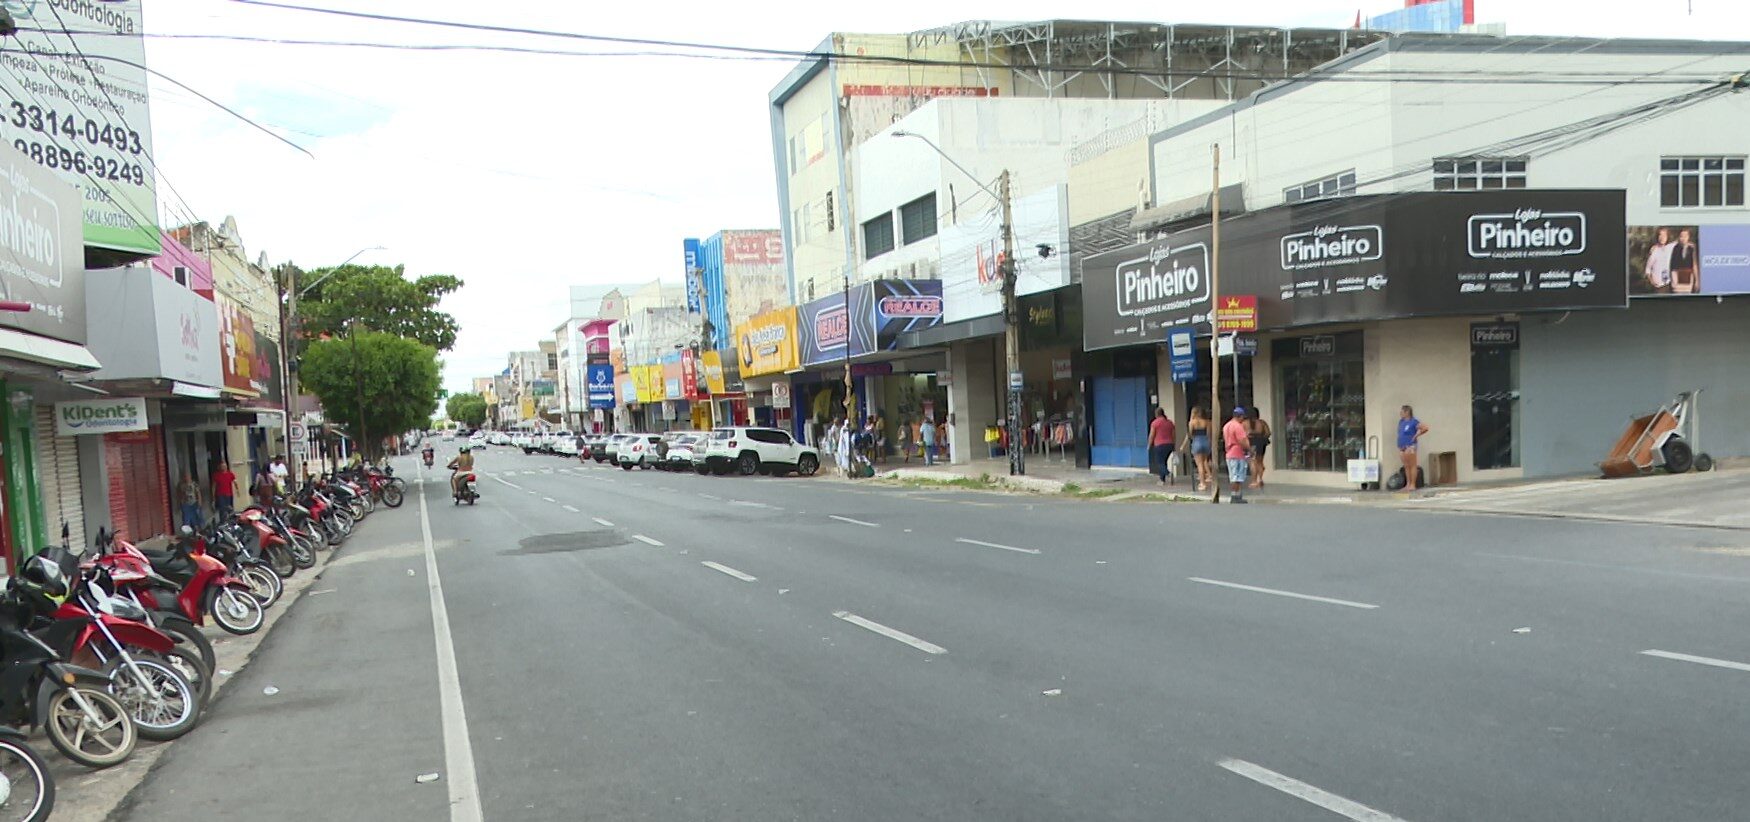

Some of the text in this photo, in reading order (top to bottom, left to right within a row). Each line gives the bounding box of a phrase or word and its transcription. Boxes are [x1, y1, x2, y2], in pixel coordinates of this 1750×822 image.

[11, 101, 142, 154] 3314-0493
[1287, 234, 1370, 262] Pinheiro
[1480, 220, 1574, 249] Pinheiro
[1125, 259, 1198, 305] Pinheiro
